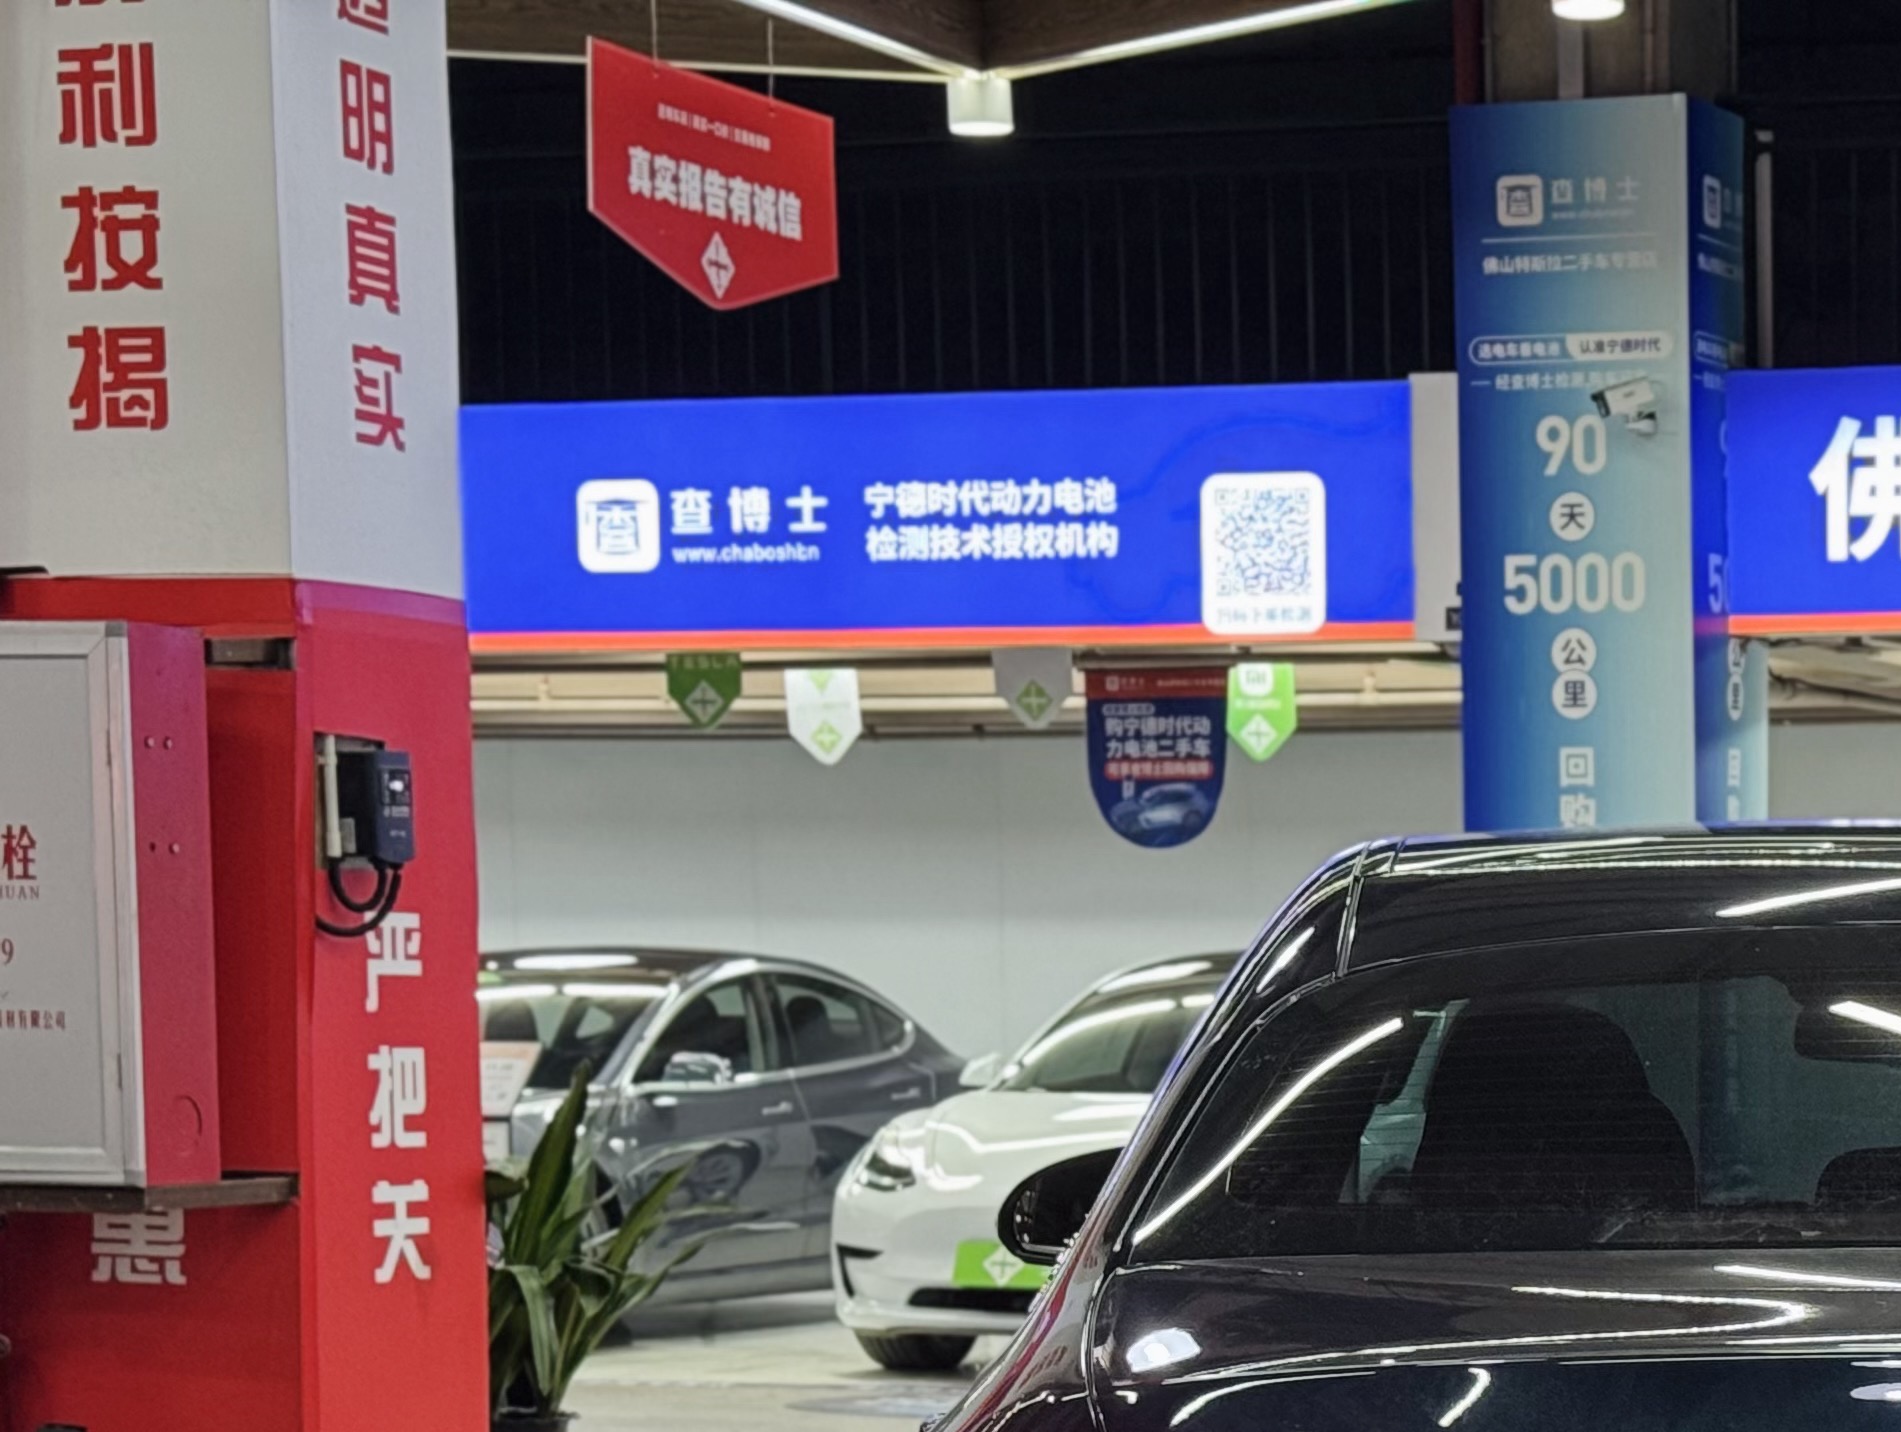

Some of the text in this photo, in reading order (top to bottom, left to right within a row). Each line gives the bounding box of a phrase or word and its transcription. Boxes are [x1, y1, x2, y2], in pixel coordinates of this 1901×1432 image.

[53, 0, 170, 431] 利按揭
[628, 145, 802, 241] 真实报告有诚信
[1536, 414, 1607, 476] 90
[669, 484, 829, 535] 查博士
[863, 477, 1118, 519] 宁德时代动力电池
[1560, 503, 1586, 531] 天
[865, 521, 1119, 562] 检测技术授权机构
[1504, 551, 1646, 615] 5000
[1561, 637, 1589, 709] 公里
[0, 824, 37, 881] 栓
